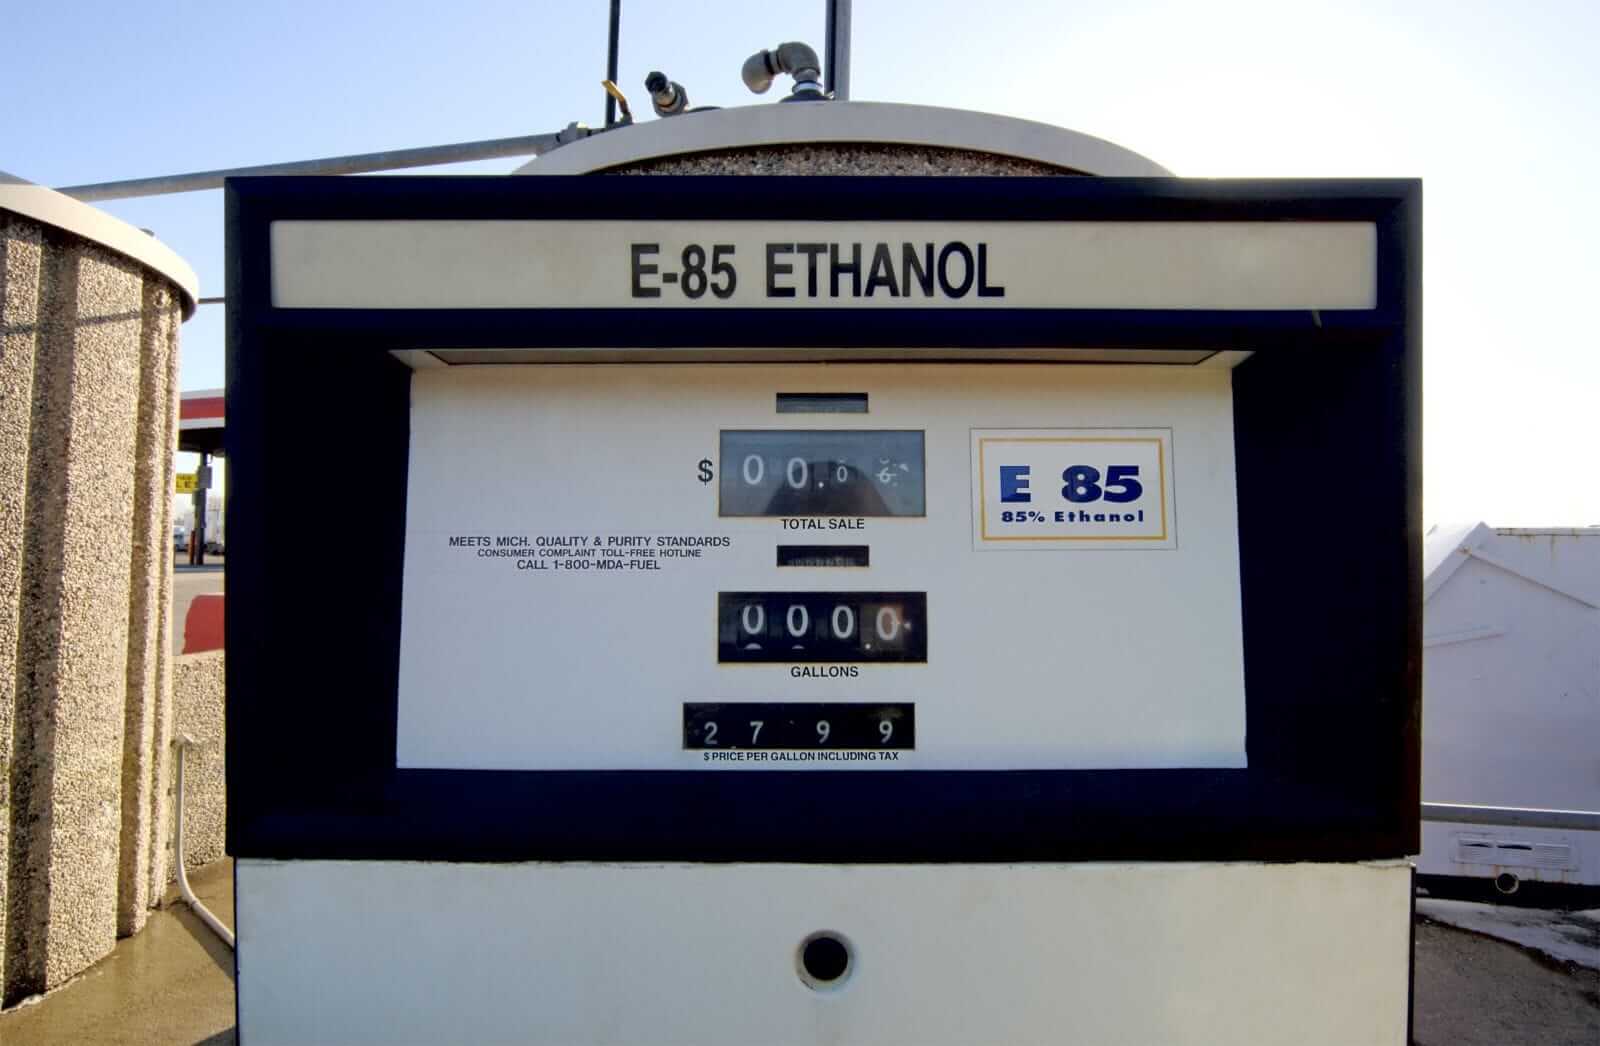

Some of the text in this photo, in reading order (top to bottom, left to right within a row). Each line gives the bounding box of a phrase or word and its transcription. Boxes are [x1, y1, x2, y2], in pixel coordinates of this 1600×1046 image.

[630, 240, 1006, 300] E-85 ETHANOL
[697, 457, 714, 486] $
[999, 464, 1143, 504] E 85
[1001, 509, 1144, 523] 85% Ethanol
[781, 518, 865, 530] TOTAL SALE
[449, 536, 731, 547] MEETS MICH. QUALITY & PURITY STANDARDS
[477, 548, 702, 558] CONSUMER COMPLAINT TOLL-FREE HOTLINE
[516, 559, 661, 570] CALL 1-800-MDA-FUEL
[790, 665, 859, 678] GALLONS
[704, 720, 894, 745] 2 7 9 9
[711, 751, 745, 761] PRICE
[746, 751, 768, 761] PER
[770, 751, 816, 761] GALLON
[817, 751, 877, 761] INCLUDING
[879, 751, 899, 761] TAX
